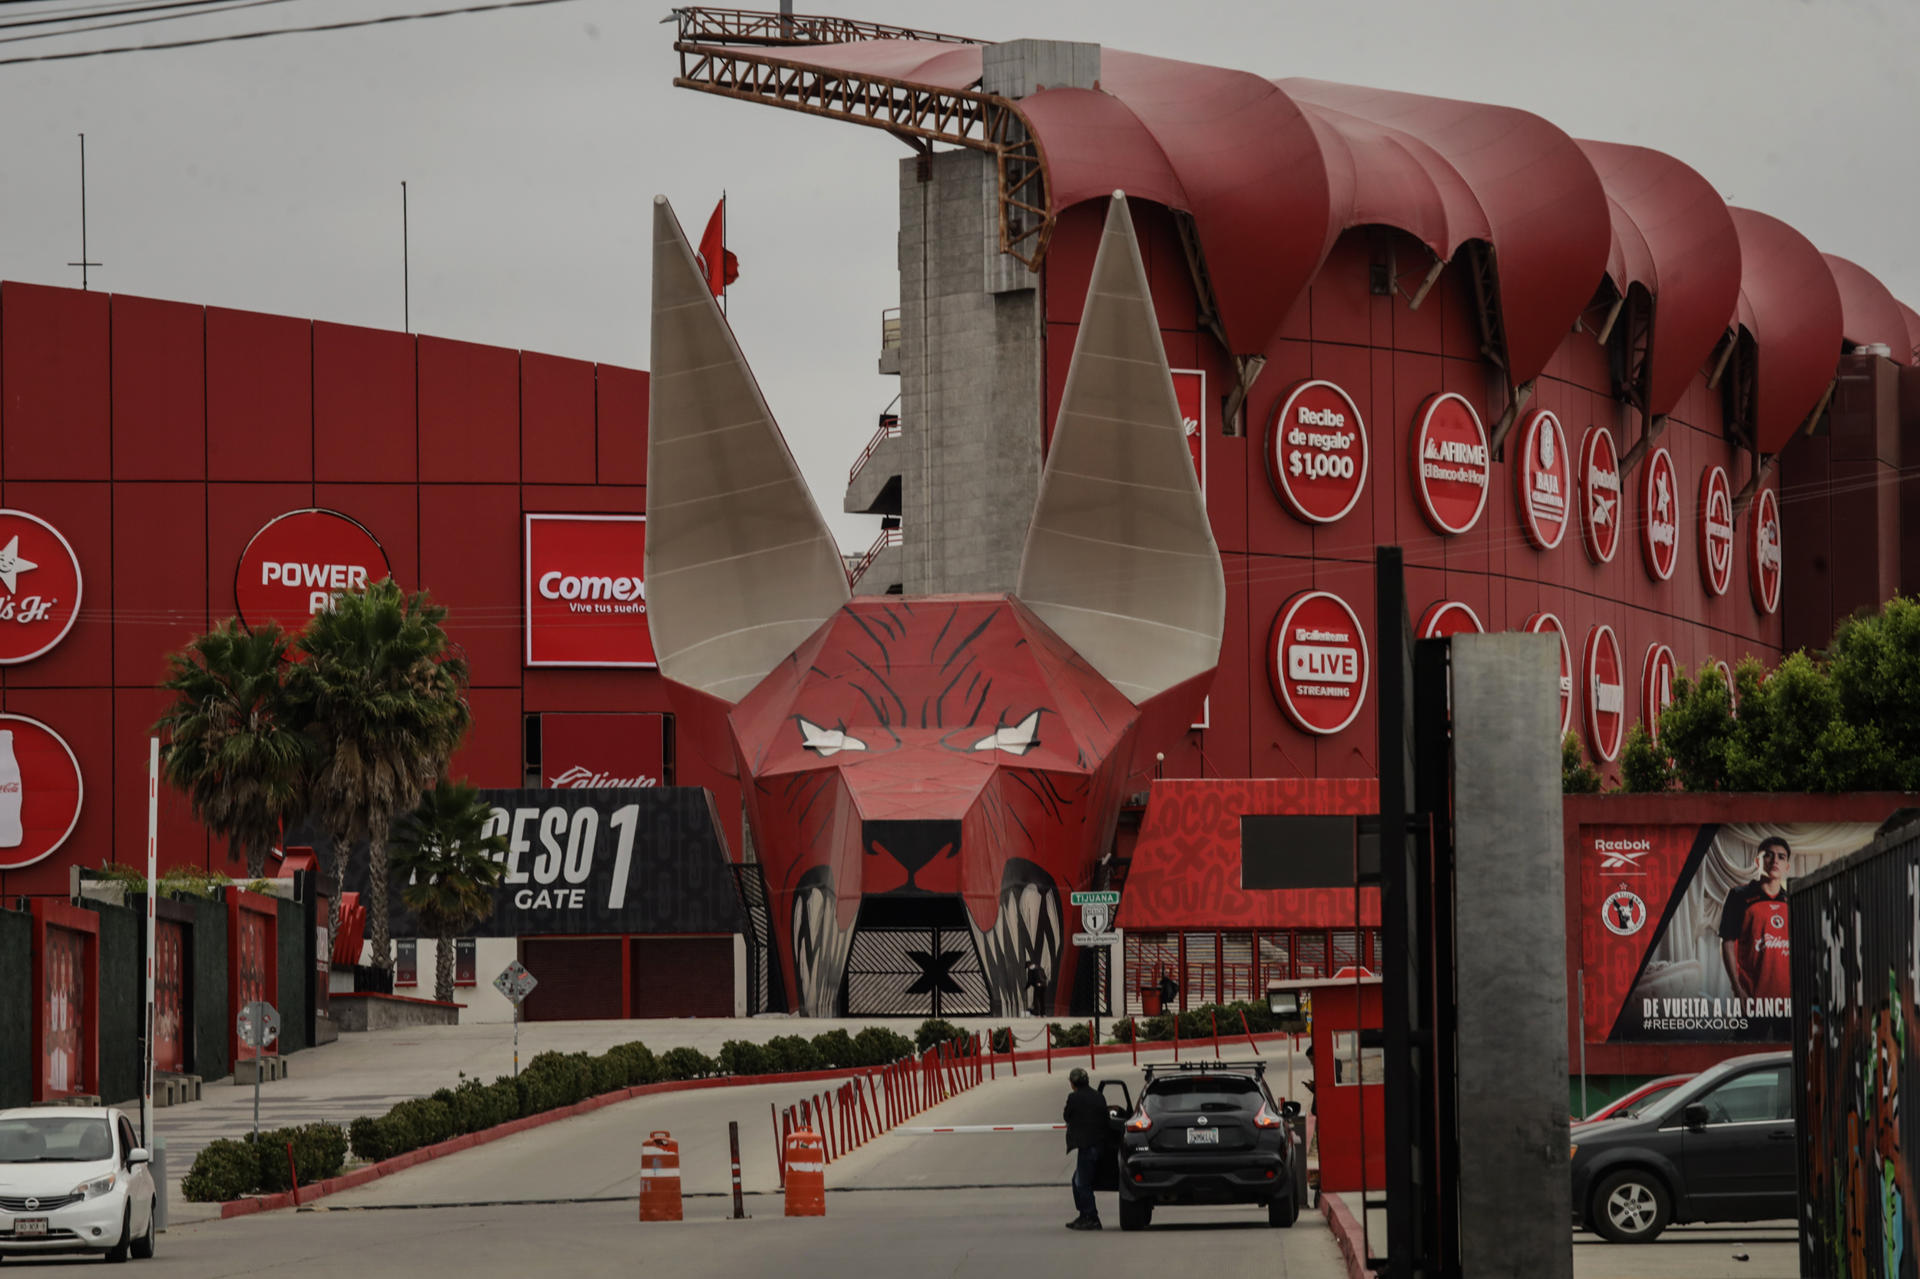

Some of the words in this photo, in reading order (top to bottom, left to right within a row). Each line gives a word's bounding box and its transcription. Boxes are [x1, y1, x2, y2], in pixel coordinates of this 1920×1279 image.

[1298, 406, 1345, 428] Recibe
[1288, 427, 1307, 445] de
[1439, 441, 1485, 466] AFIRME
[1289, 449, 1354, 480] $1,000
[1425, 463, 1433, 478] El
[1433, 464, 1457, 481] Banco
[1457, 467, 1468, 482] de
[1468, 469, 1485, 487] Hoy
[1535, 471, 1559, 494] BAJA
[261, 561, 367, 590] POWER
[539, 571, 646, 602] Comex
[569, 602, 592, 613] Vive
[595, 602, 612, 613] tus
[1309, 653, 1353, 675] LIVE
[1296, 685, 1350, 697] STREAMING
[1595, 839, 1650, 851] Reebok
[609, 804, 639, 909] 1
[513, 889, 586, 909] GATE
[1076, 893, 1114, 903] TIJUANA
[1092, 916, 1097, 928] 1
[1643, 997, 1659, 1018] DE
[1663, 997, 1710, 1018] VUELTA
[1713, 997, 1722, 1018] A
[1726, 997, 1742, 1018] LA
[1643, 1018, 1749, 1030] #REEBOKXOLOS
